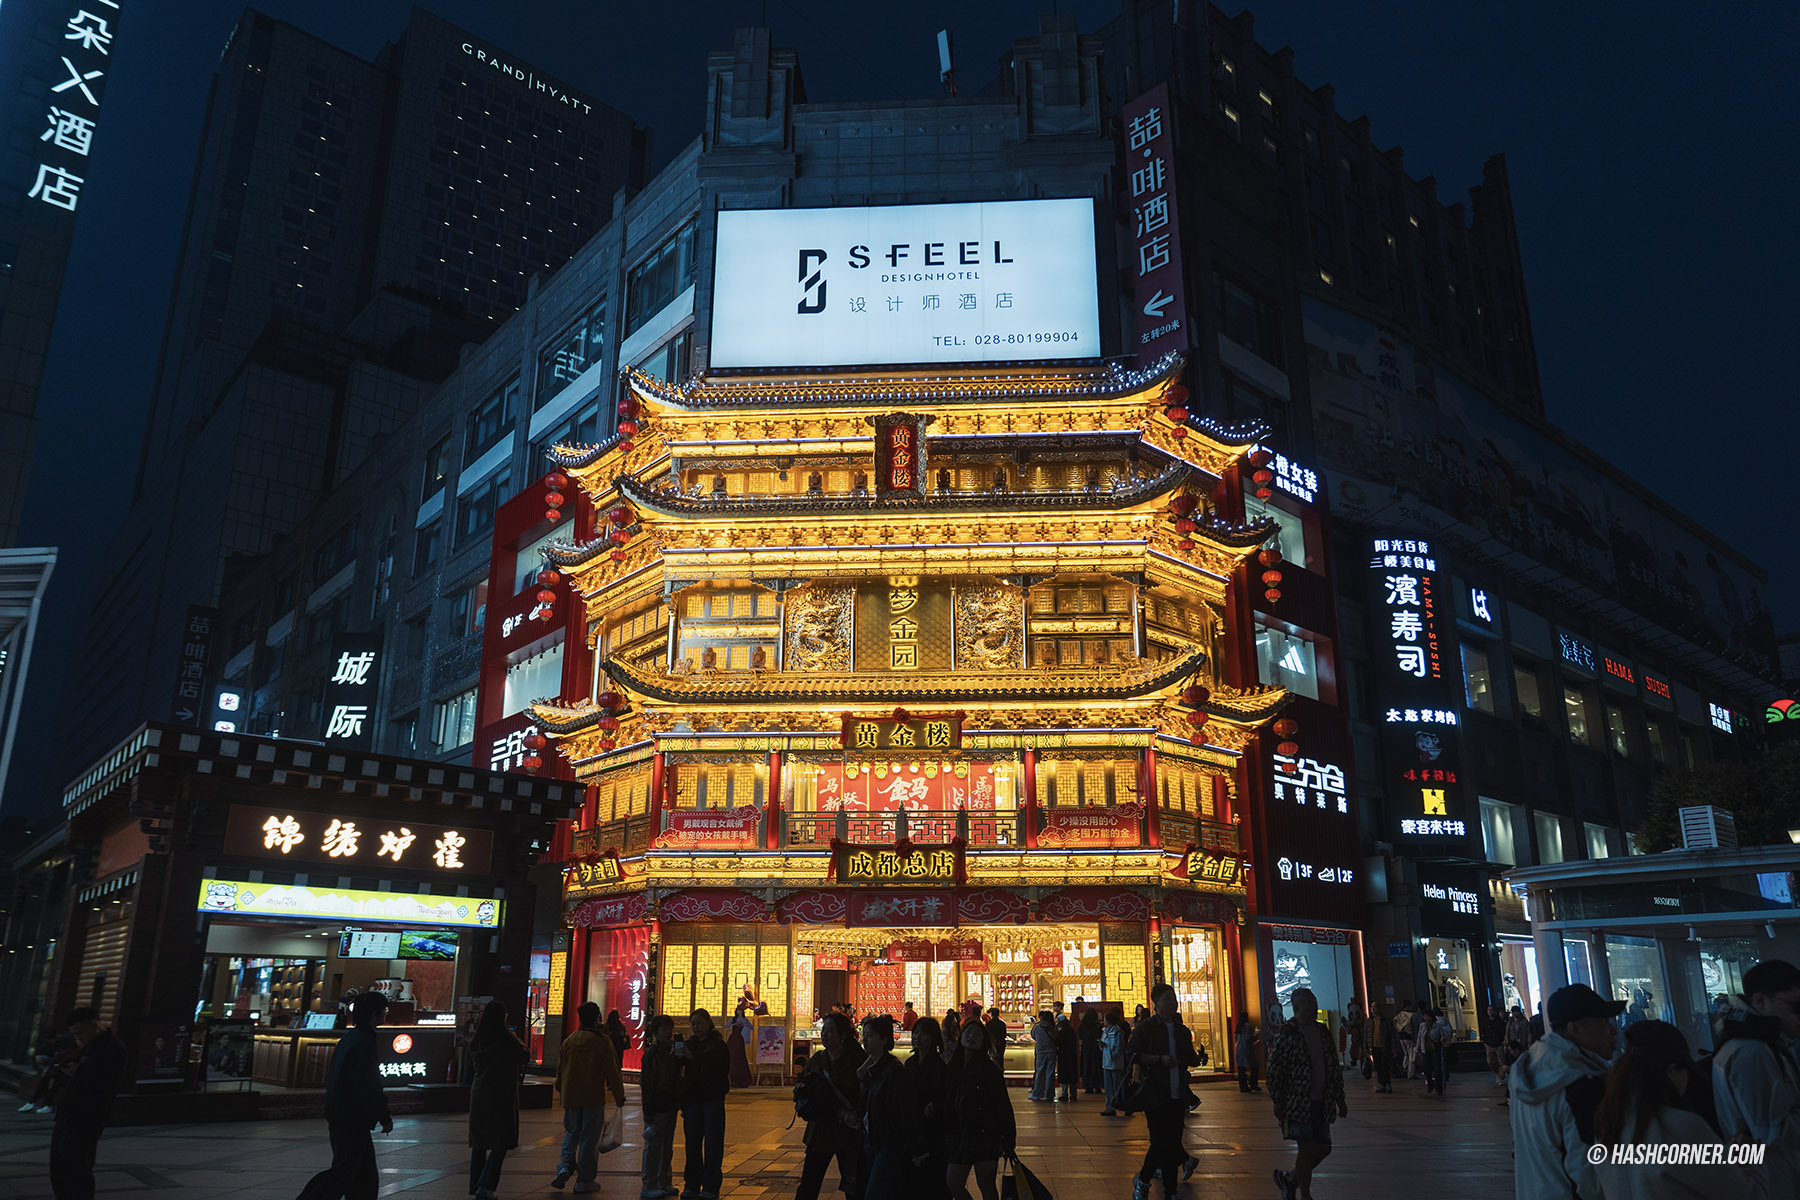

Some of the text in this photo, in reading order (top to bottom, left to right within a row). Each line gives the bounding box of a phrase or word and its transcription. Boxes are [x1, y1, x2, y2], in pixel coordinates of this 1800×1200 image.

[462, 43, 592, 115] GRAND HYATT
[881, 271, 981, 283] DESIGNHOTEL
[849, 292, 1014, 313] 设计师酒店
[974, 331, 1079, 346] 028-80199904
[1141, 319, 1182, 345] 左转20米
[891, 428, 911, 488] 黄金楼
[1374, 540, 1428, 554] 阳光百货
[1472, 588, 1492, 622] は
[890, 588, 918, 670] 梦金园
[1384, 574, 1427, 678] 濱寿司
[1605, 656, 1671, 699] HAMA SUSHI
[325, 652, 376, 738] 城际
[854, 722, 951, 748] 黄金楼
[1060, 816, 1118, 826] 少操没用的心
[262, 815, 466, 868] 锦绣炉霍
[849, 850, 955, 878] 成都总店
[1187, 851, 1237, 880] 梦金园
[1301, 864, 1313, 878] 3F
[1341, 869, 1353, 884] 2F
[1423, 884, 1478, 903] Helen Princess
